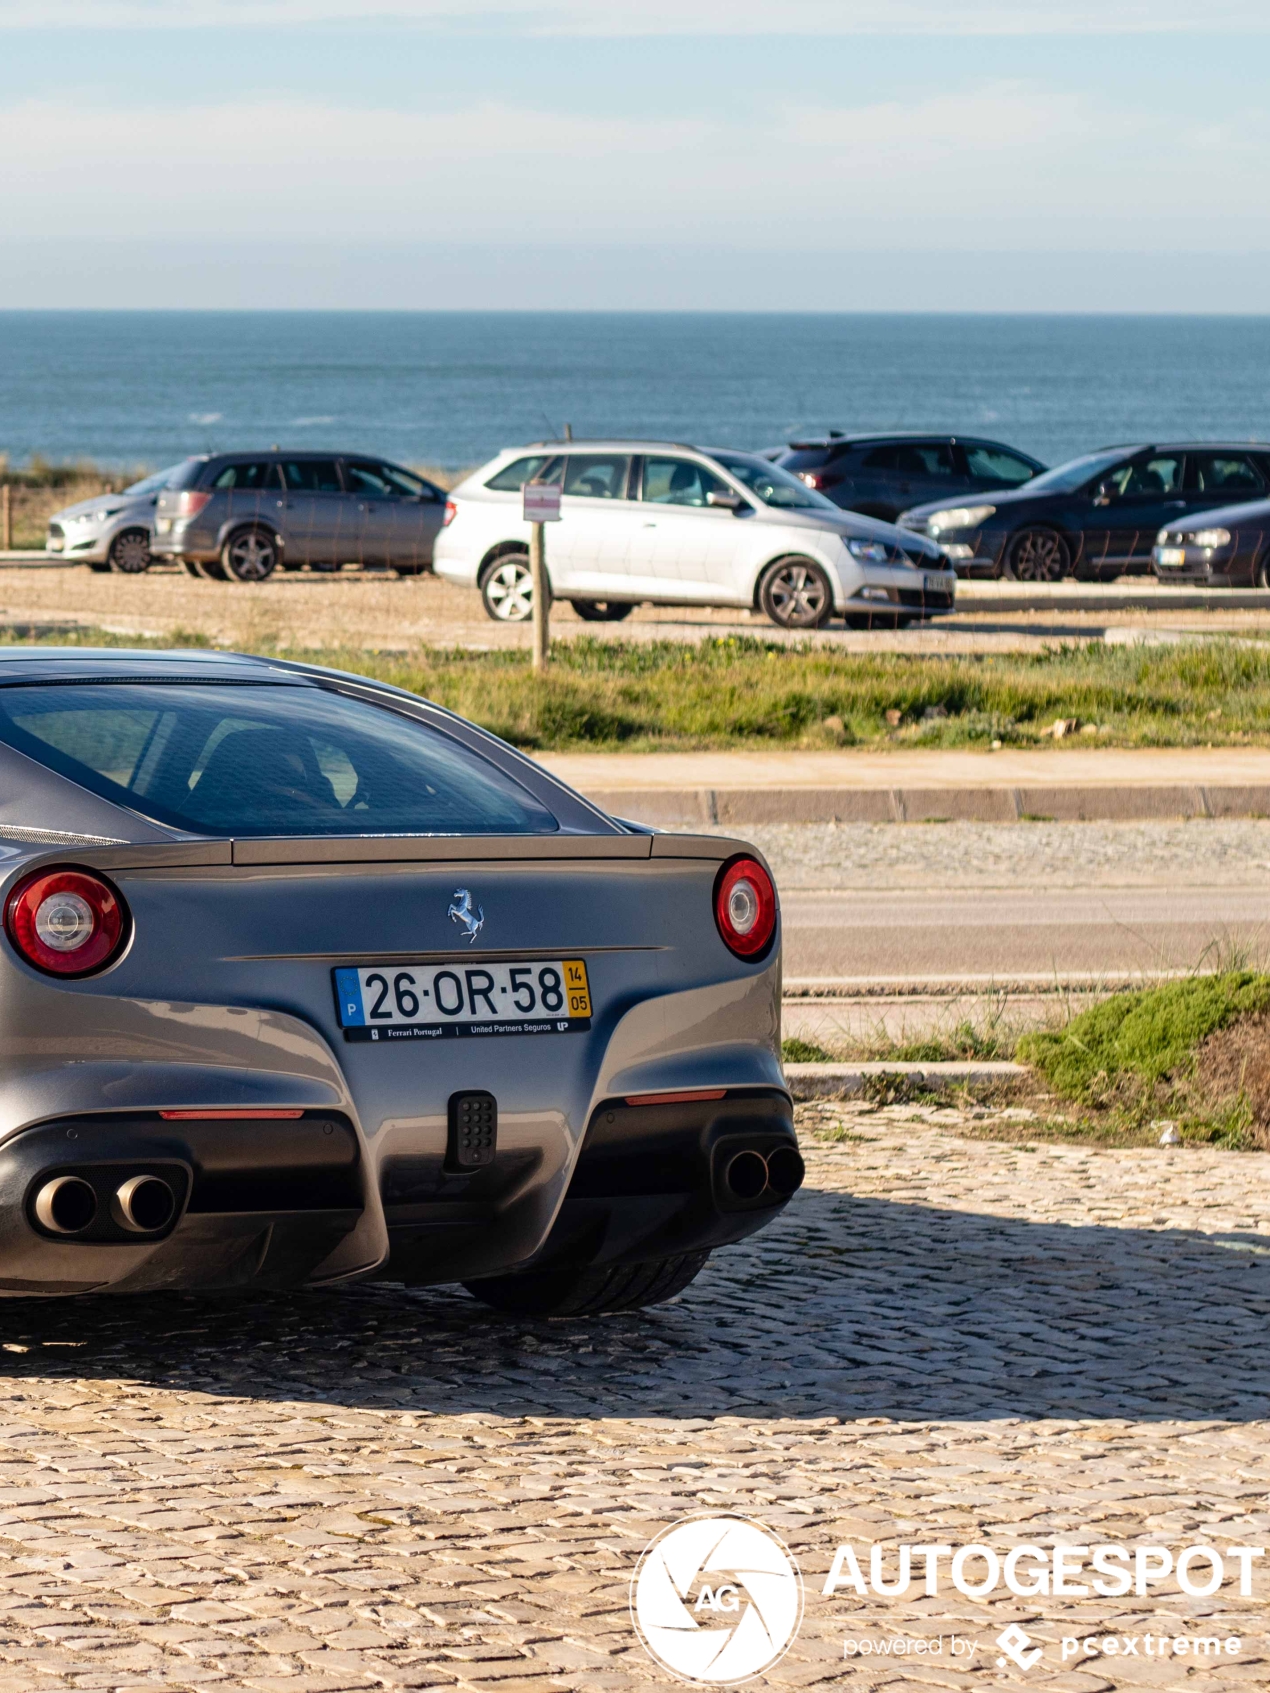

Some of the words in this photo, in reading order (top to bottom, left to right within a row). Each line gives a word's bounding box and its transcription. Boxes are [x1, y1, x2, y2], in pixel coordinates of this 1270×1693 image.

[568, 966, 582, 982] 14
[347, 1003, 357, 1016] P
[570, 995, 588, 1012] 05
[387, 1028, 412, 1037] Ferrari
[413, 1027, 443, 1038] Portugal
[470, 1024, 493, 1034] United
[493, 1024, 523, 1033] Partners
[523, 1023, 552, 1034] Seguros
